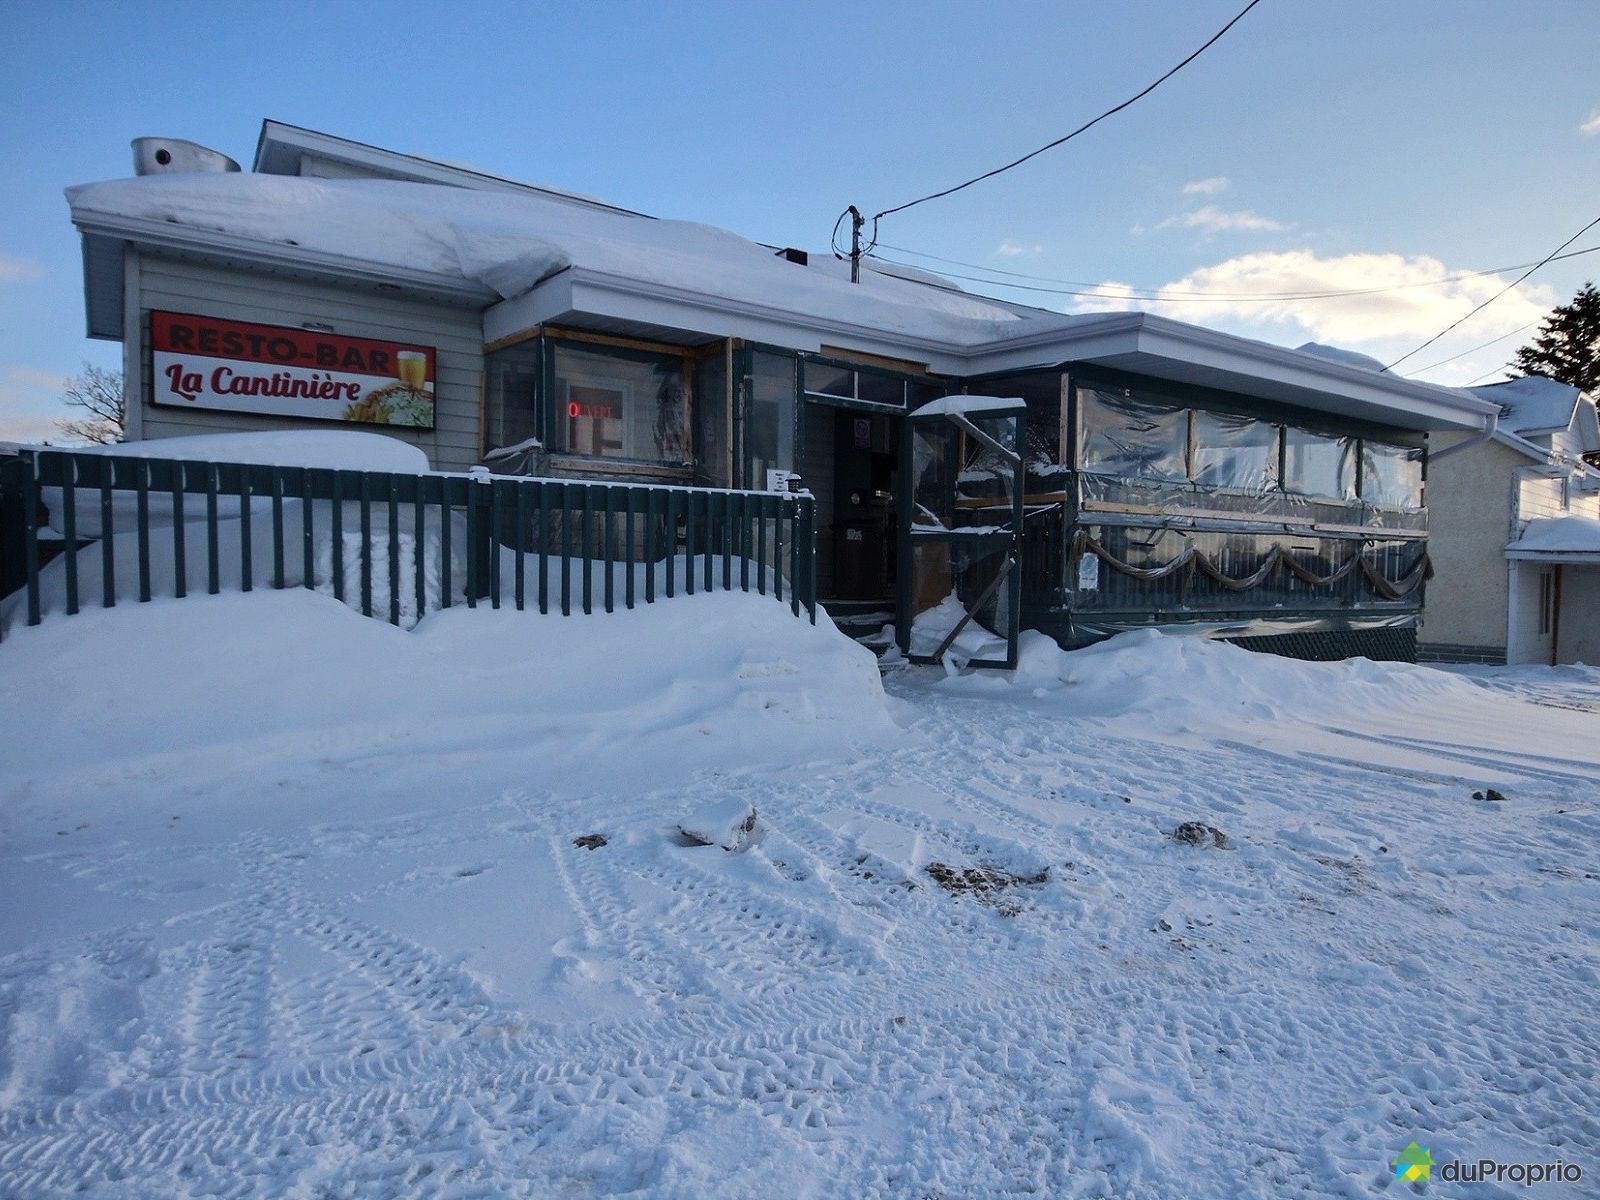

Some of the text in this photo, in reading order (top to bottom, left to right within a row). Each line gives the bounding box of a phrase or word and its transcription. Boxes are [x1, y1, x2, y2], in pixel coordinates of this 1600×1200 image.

[169, 324, 389, 373] RESTO-BAR
[165, 363, 361, 401] La Cantinière
